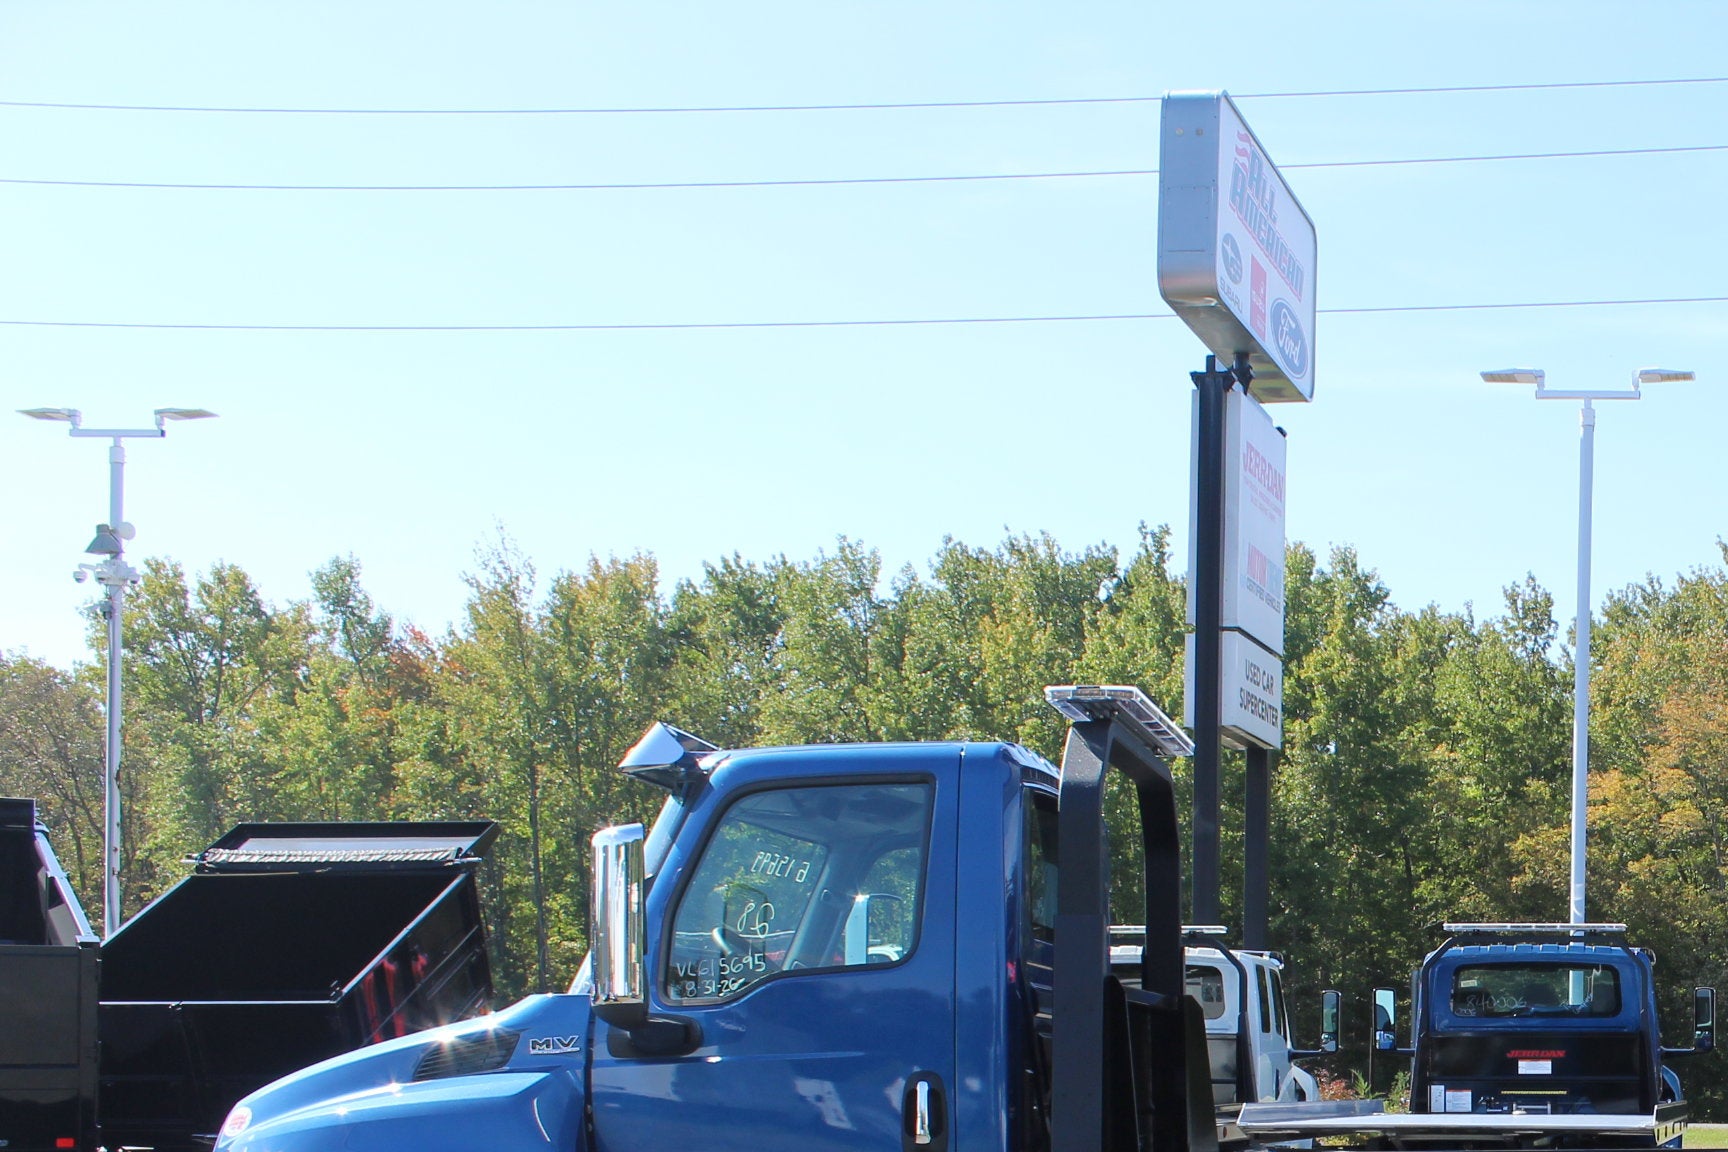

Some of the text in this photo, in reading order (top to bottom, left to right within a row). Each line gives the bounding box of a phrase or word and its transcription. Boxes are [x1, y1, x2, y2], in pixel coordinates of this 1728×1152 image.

[1248, 145, 1279, 226] ALL
[1229, 158, 1304, 302] AMERICAN
[1279, 308, 1300, 367] Ford
[1245, 658, 1275, 696] USED CAR
[1239, 687, 1279, 729] SUPERCENTER
[530, 1036, 579, 1051] MV
